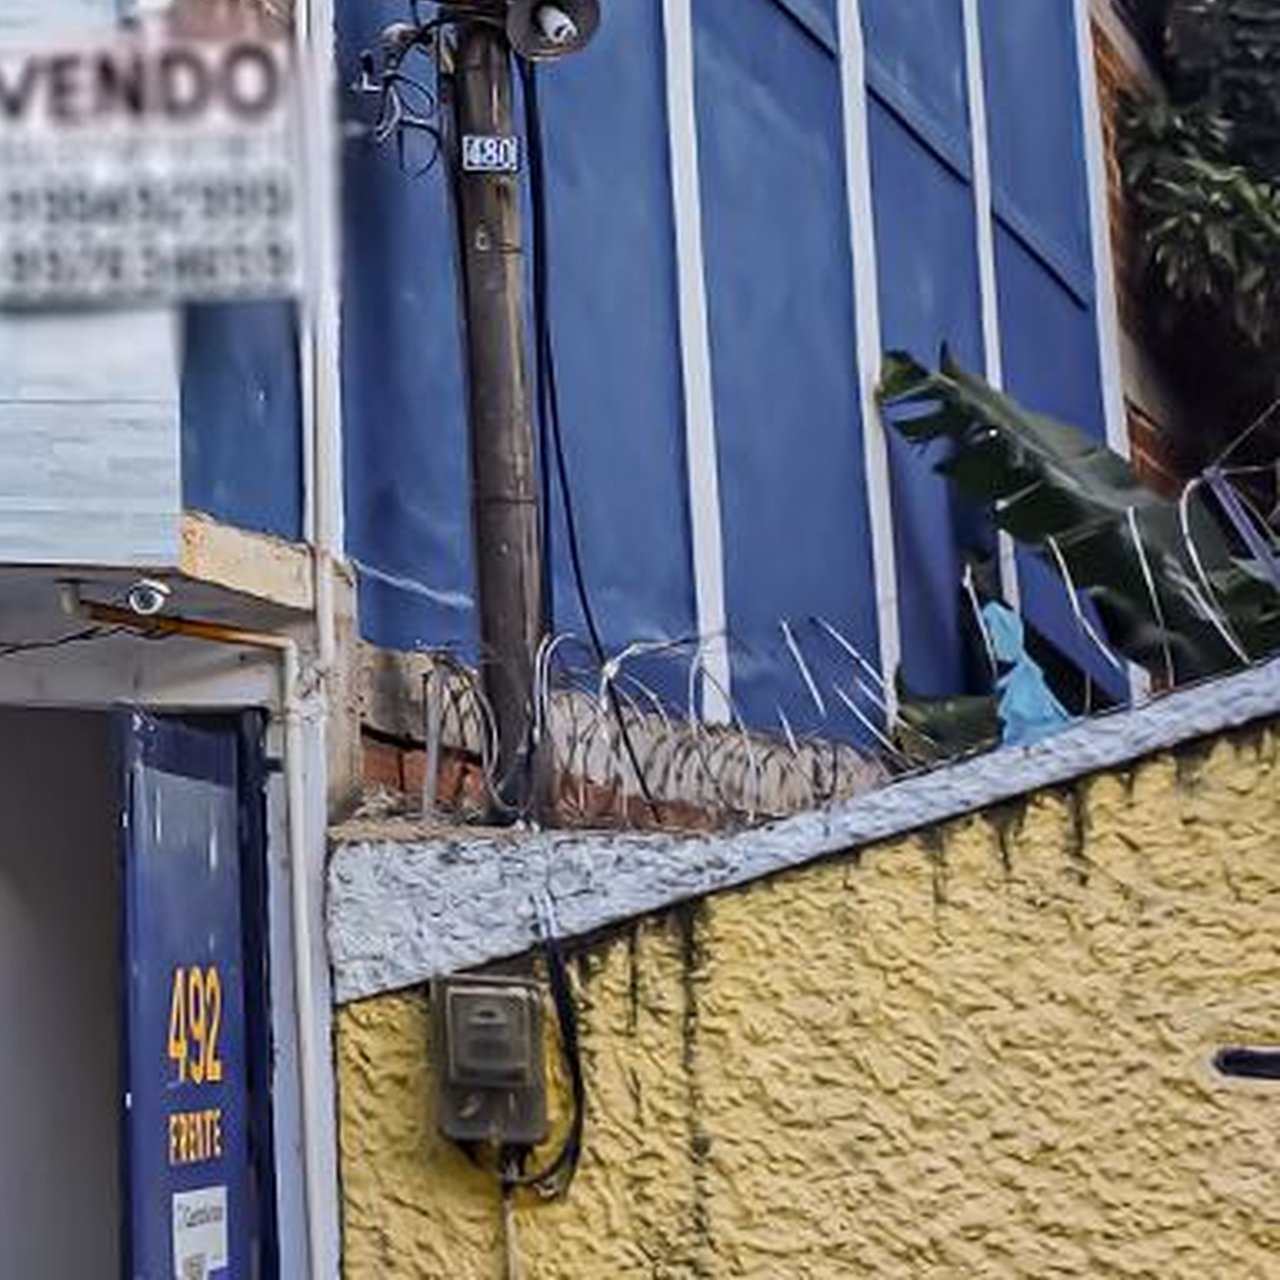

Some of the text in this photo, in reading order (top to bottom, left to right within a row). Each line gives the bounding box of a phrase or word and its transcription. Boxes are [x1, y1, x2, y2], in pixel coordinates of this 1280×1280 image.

[466, 138, 514, 168] 480
[168, 966, 223, 1083] 492
[168, 1109, 222, 1166] FRENTE
